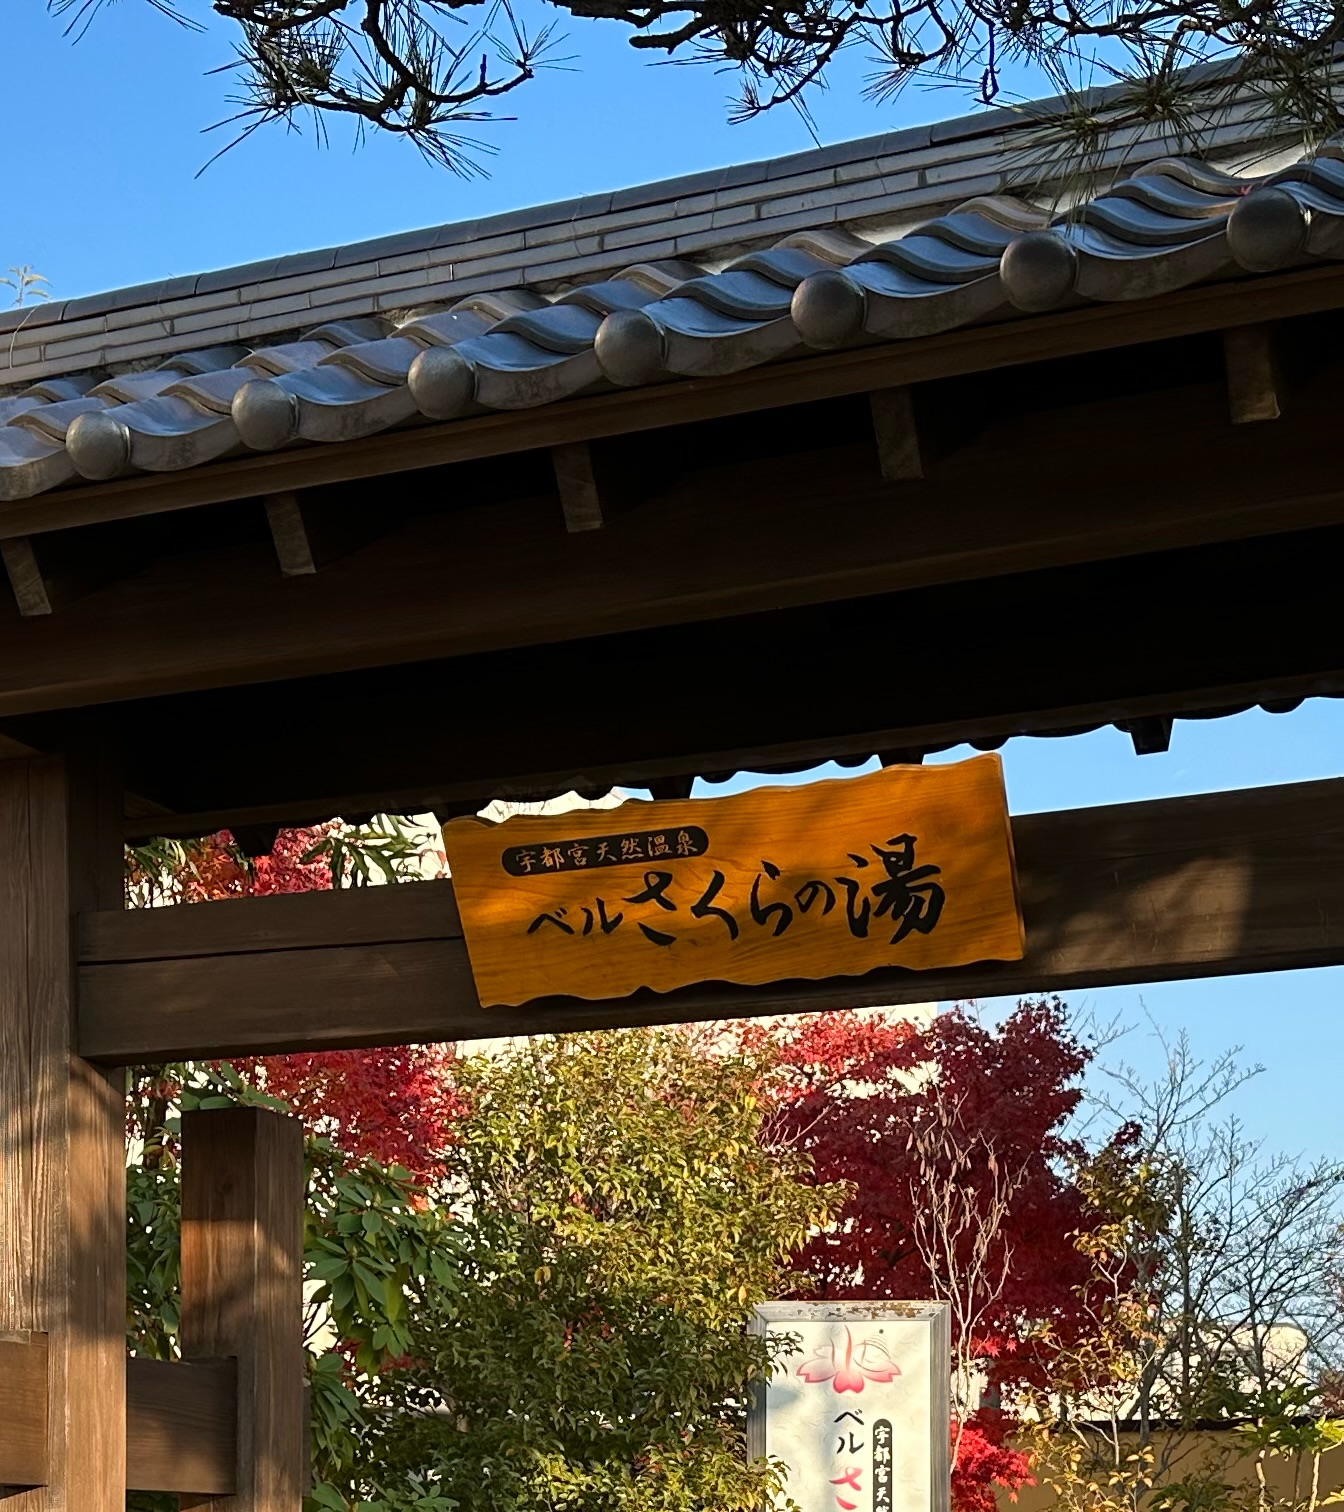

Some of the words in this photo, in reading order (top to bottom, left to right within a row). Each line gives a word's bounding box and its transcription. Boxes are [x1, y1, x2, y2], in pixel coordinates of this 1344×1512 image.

[515, 829, 698, 873] 宇都宮天然温泉
[527, 833, 946, 945] ベルさくらの湯
